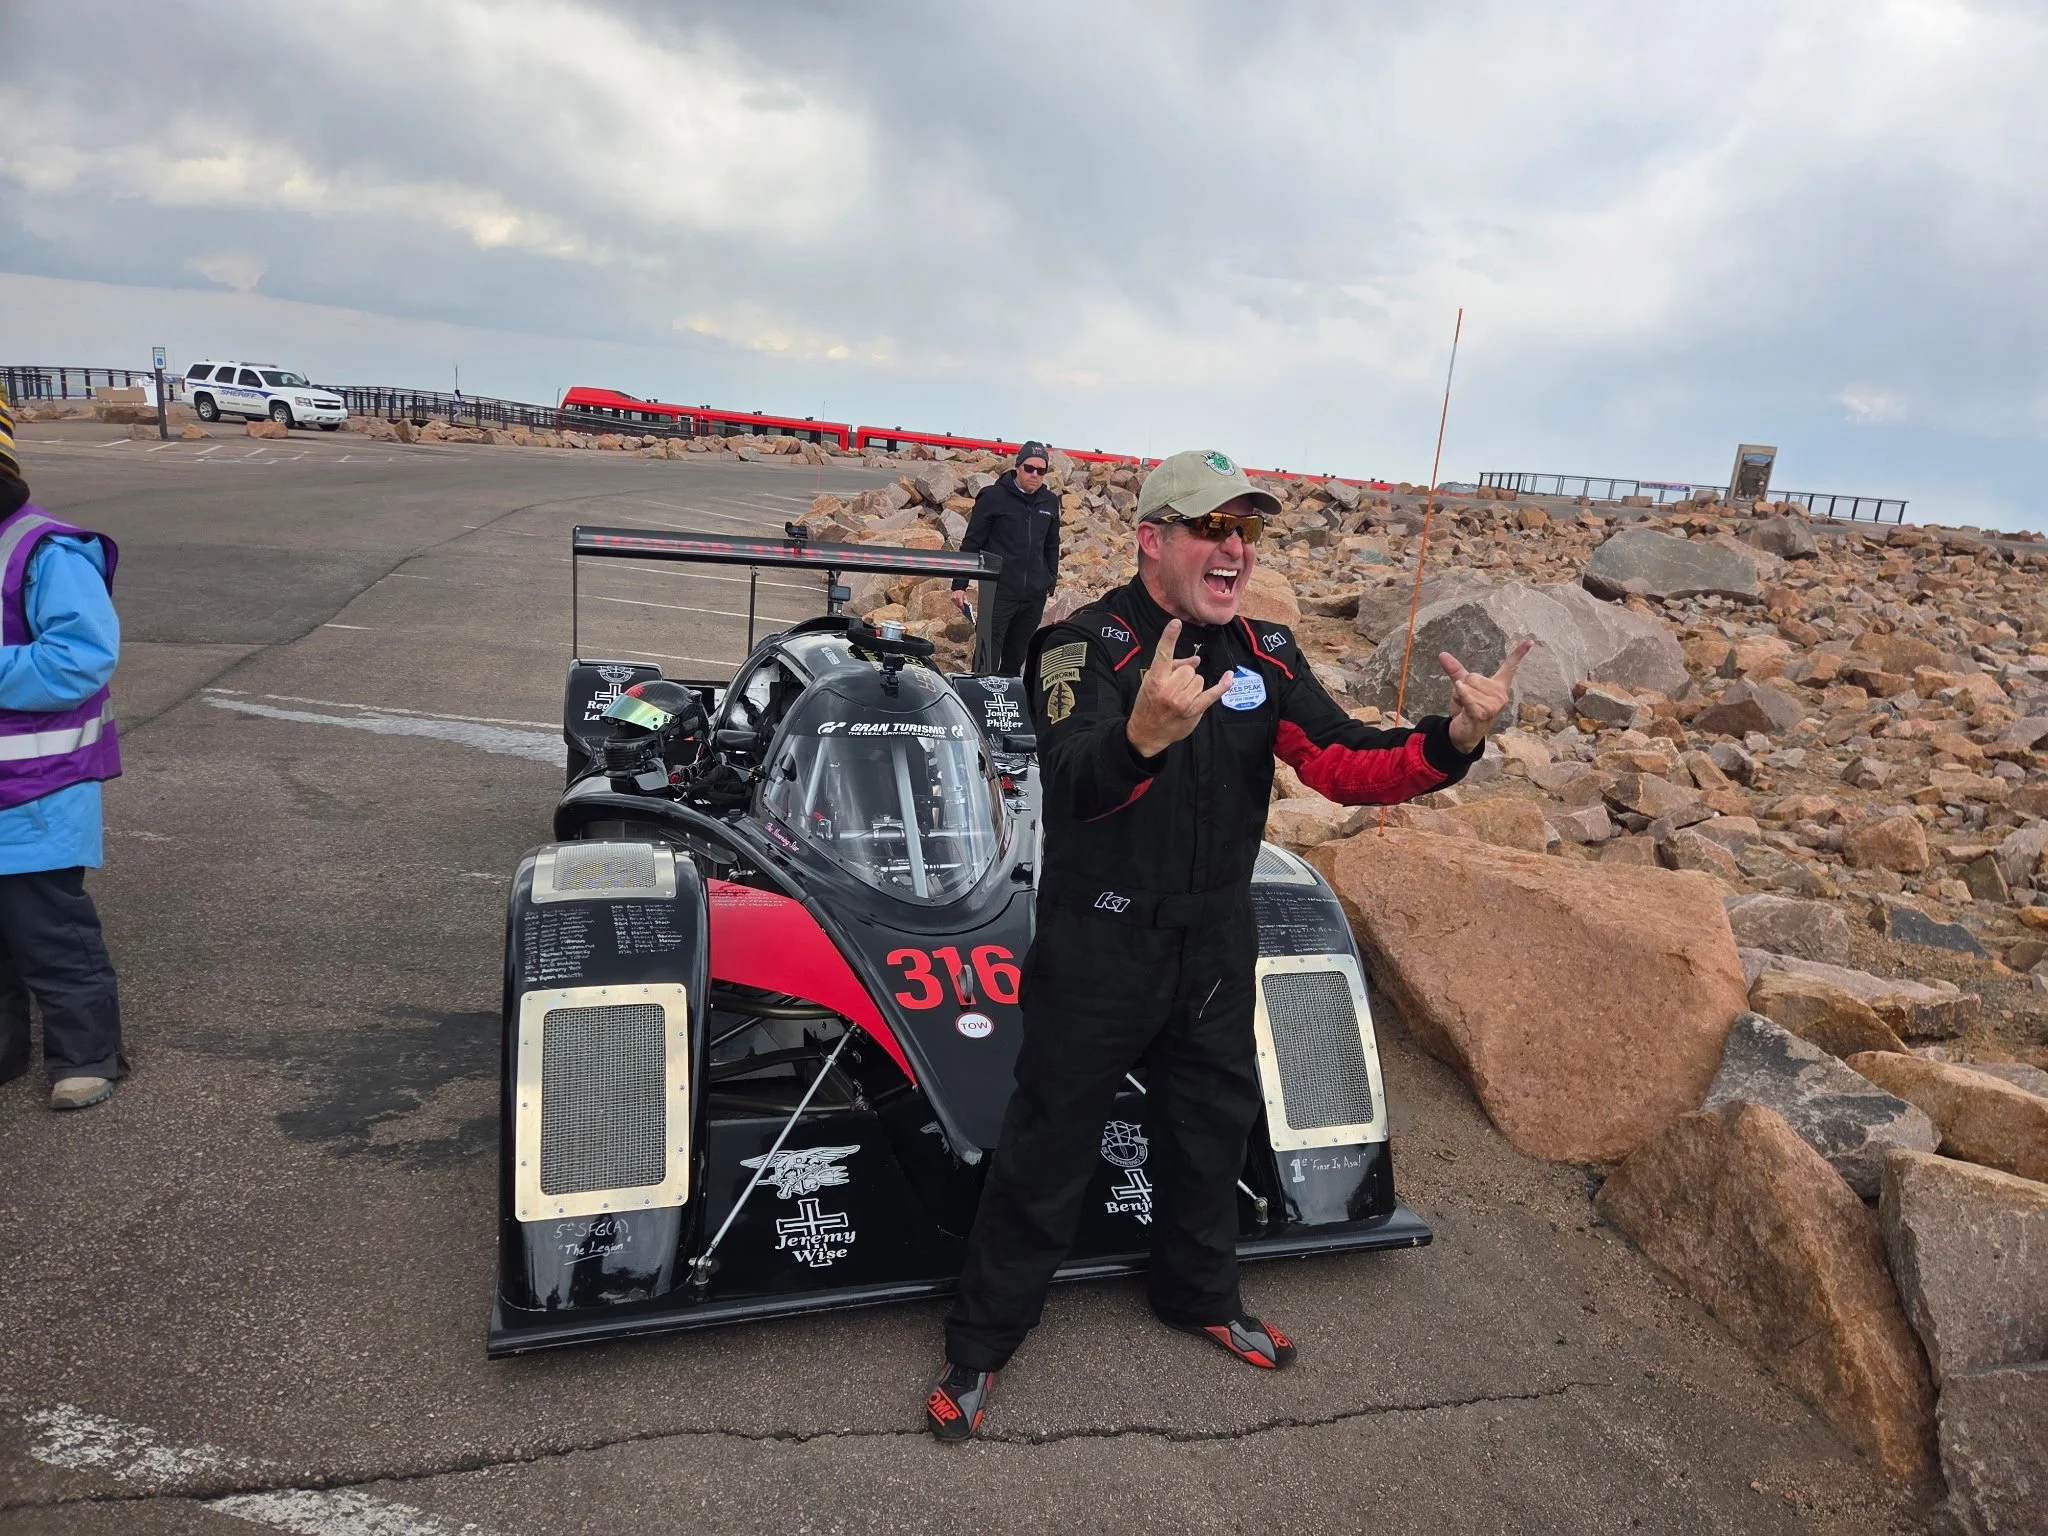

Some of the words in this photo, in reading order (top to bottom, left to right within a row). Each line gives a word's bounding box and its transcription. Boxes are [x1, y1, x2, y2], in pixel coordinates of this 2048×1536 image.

[221, 389, 258, 399] SHERIFF
[1044, 670, 1077, 685] AIRBORNE
[583, 711, 600, 721] La
[985, 709, 1020, 720] Joseph
[850, 723, 890, 732] GRAN
[892, 723, 947, 735] TURISMO
[986, 719, 1023, 729] Phister
[887, 944, 1021, 1010] 316
[960, 1021, 989, 1031] TOW
[1105, 1199, 1152, 1214] Benj
[774, 1231, 856, 1250] Jeremy
[791, 1248, 848, 1263] Wise
[928, 1391, 957, 1420] OMP
